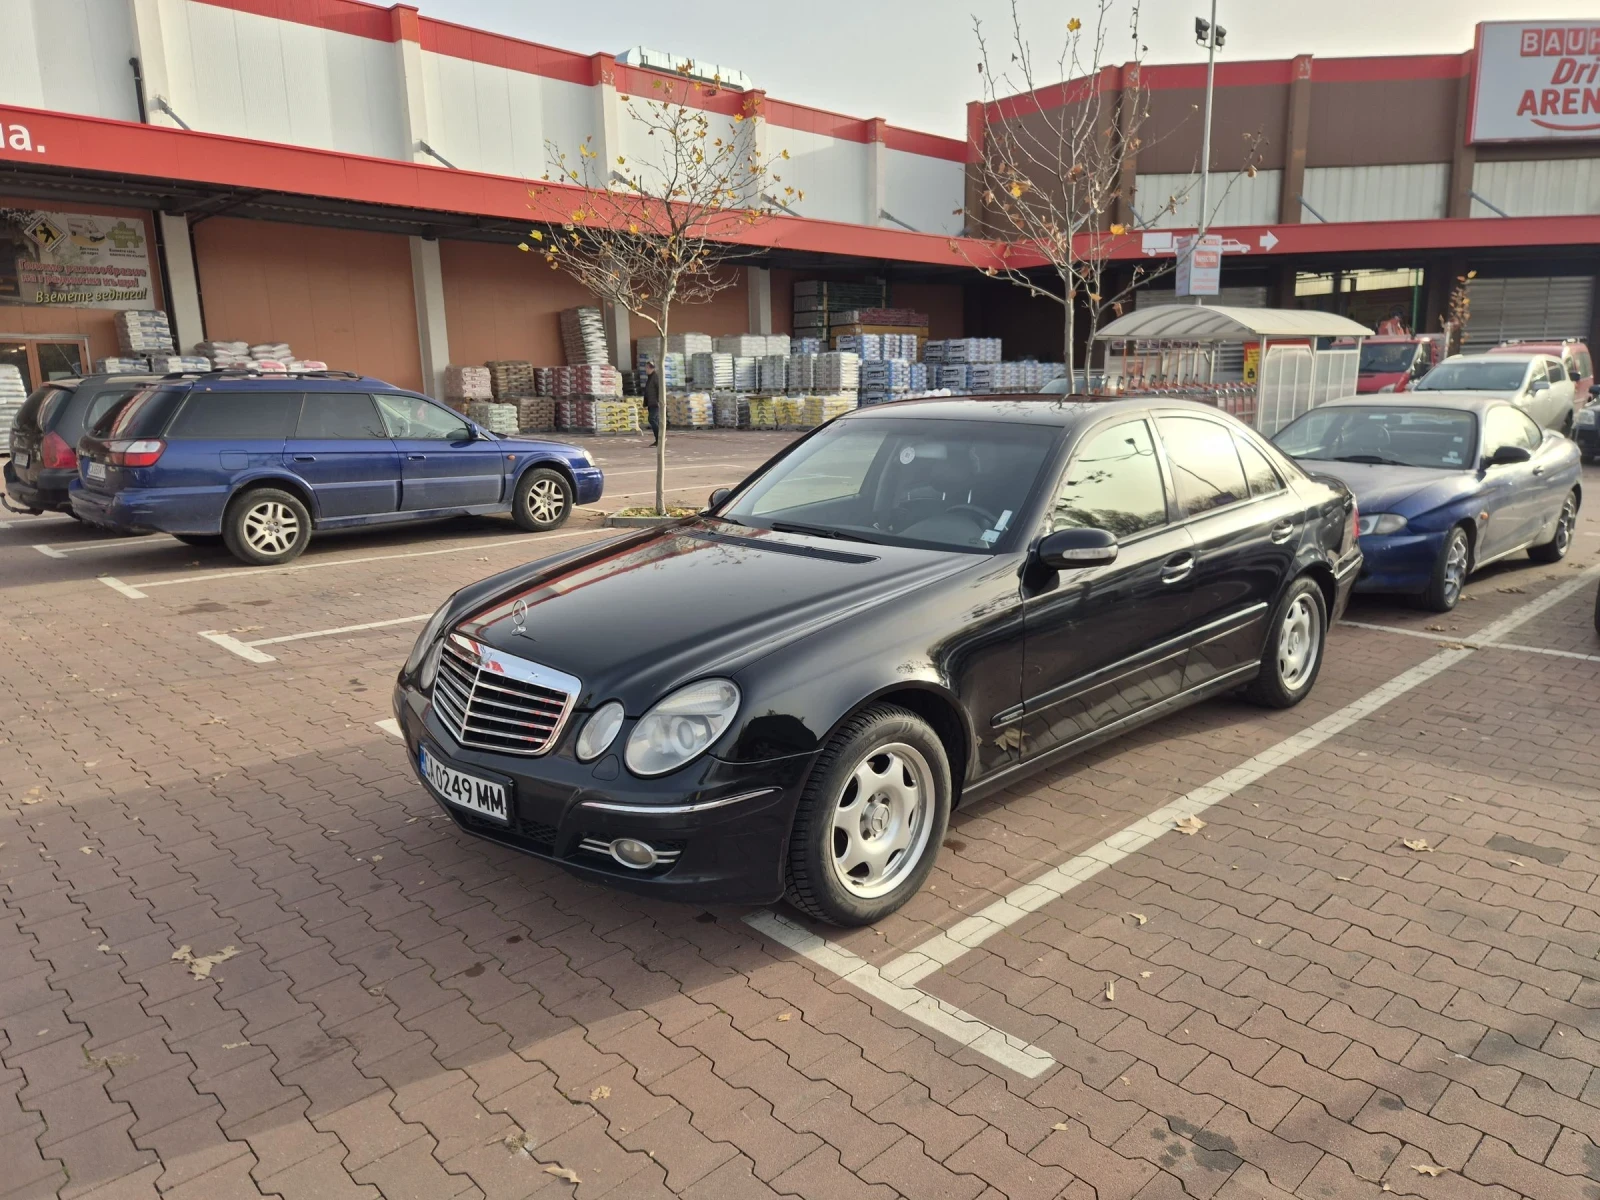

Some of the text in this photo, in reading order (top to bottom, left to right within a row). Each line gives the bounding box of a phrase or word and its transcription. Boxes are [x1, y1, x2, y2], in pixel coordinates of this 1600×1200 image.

[1516, 88, 1600, 116] AREN
[22, 274, 36, 283] на
[66, 264, 146, 278] разнообразие
[36, 287, 147, 303] Вземете веднага!
[476, 781, 504, 815] MM
